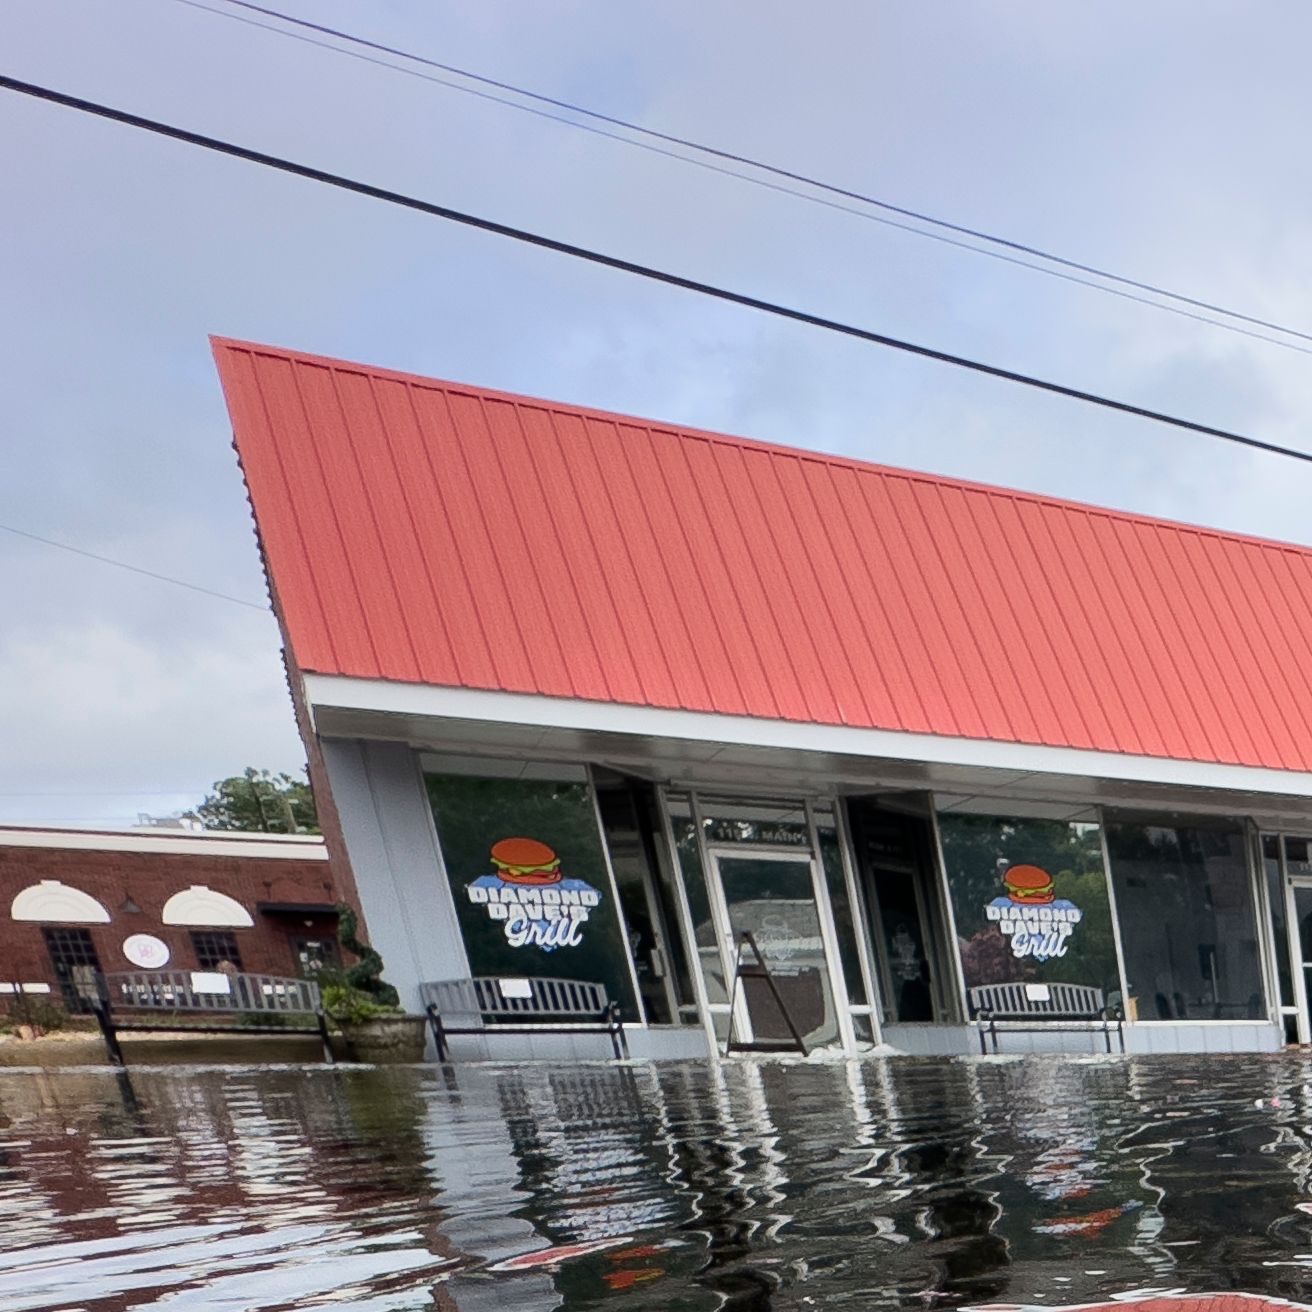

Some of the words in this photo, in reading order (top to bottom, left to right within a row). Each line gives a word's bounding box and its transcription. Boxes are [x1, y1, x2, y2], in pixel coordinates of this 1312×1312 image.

[467, 885, 600, 907] DIAMOND
[985, 905, 1082, 924] DIAMOND
[503, 916, 584, 948] Grill
[1010, 931, 1069, 958] Grill
